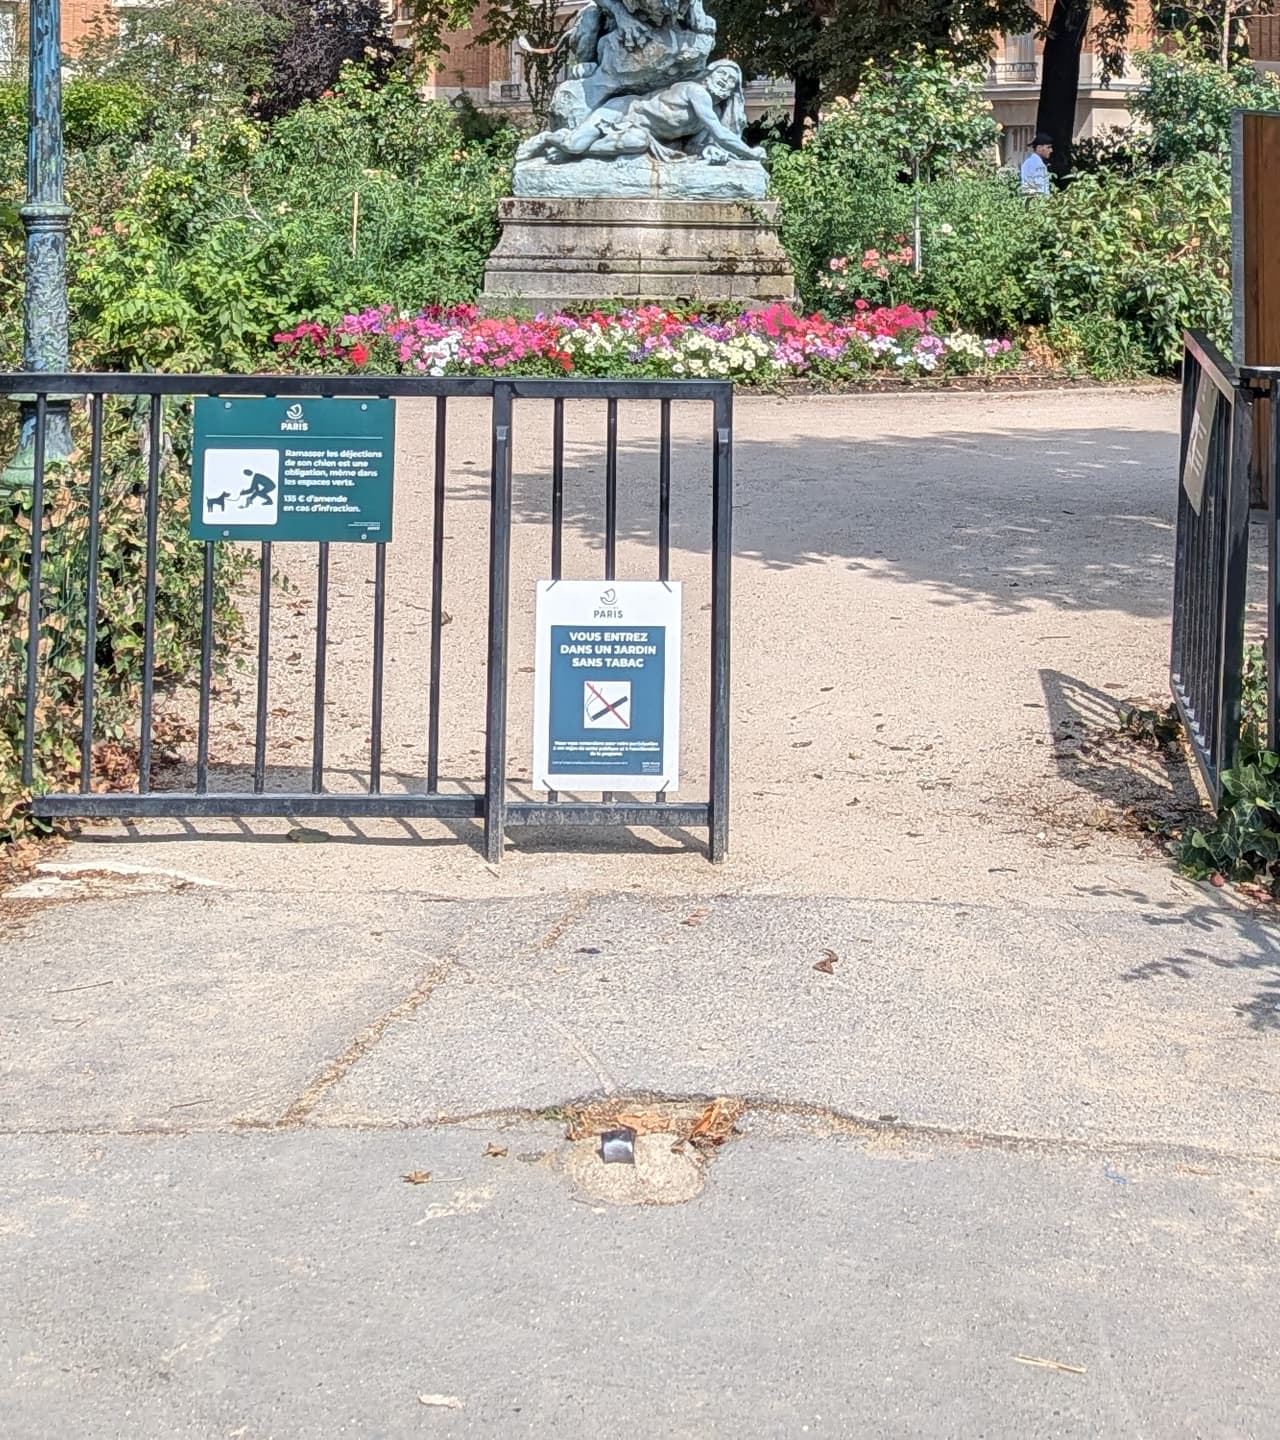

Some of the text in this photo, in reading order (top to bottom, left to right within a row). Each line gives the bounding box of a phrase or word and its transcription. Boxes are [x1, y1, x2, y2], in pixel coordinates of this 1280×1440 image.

[281, 422, 309, 431] PARIS
[285, 449, 383, 459] Ramasser les déjections
[284, 459, 296, 467] de
[313, 459, 336, 467] chien
[284, 468, 329, 477] obligation,
[357, 469, 378, 477] dans
[284, 478, 355, 487] les espaces verts.
[283, 494, 297, 502] 135
[298, 494, 305, 502] €
[593, 610, 623, 619] PARIS
[569, 632, 648, 642] VOUS ENTREZ
[560, 644, 656, 655] DANS UN JARDIN
[572, 658, 644, 668] SANS TABAC
